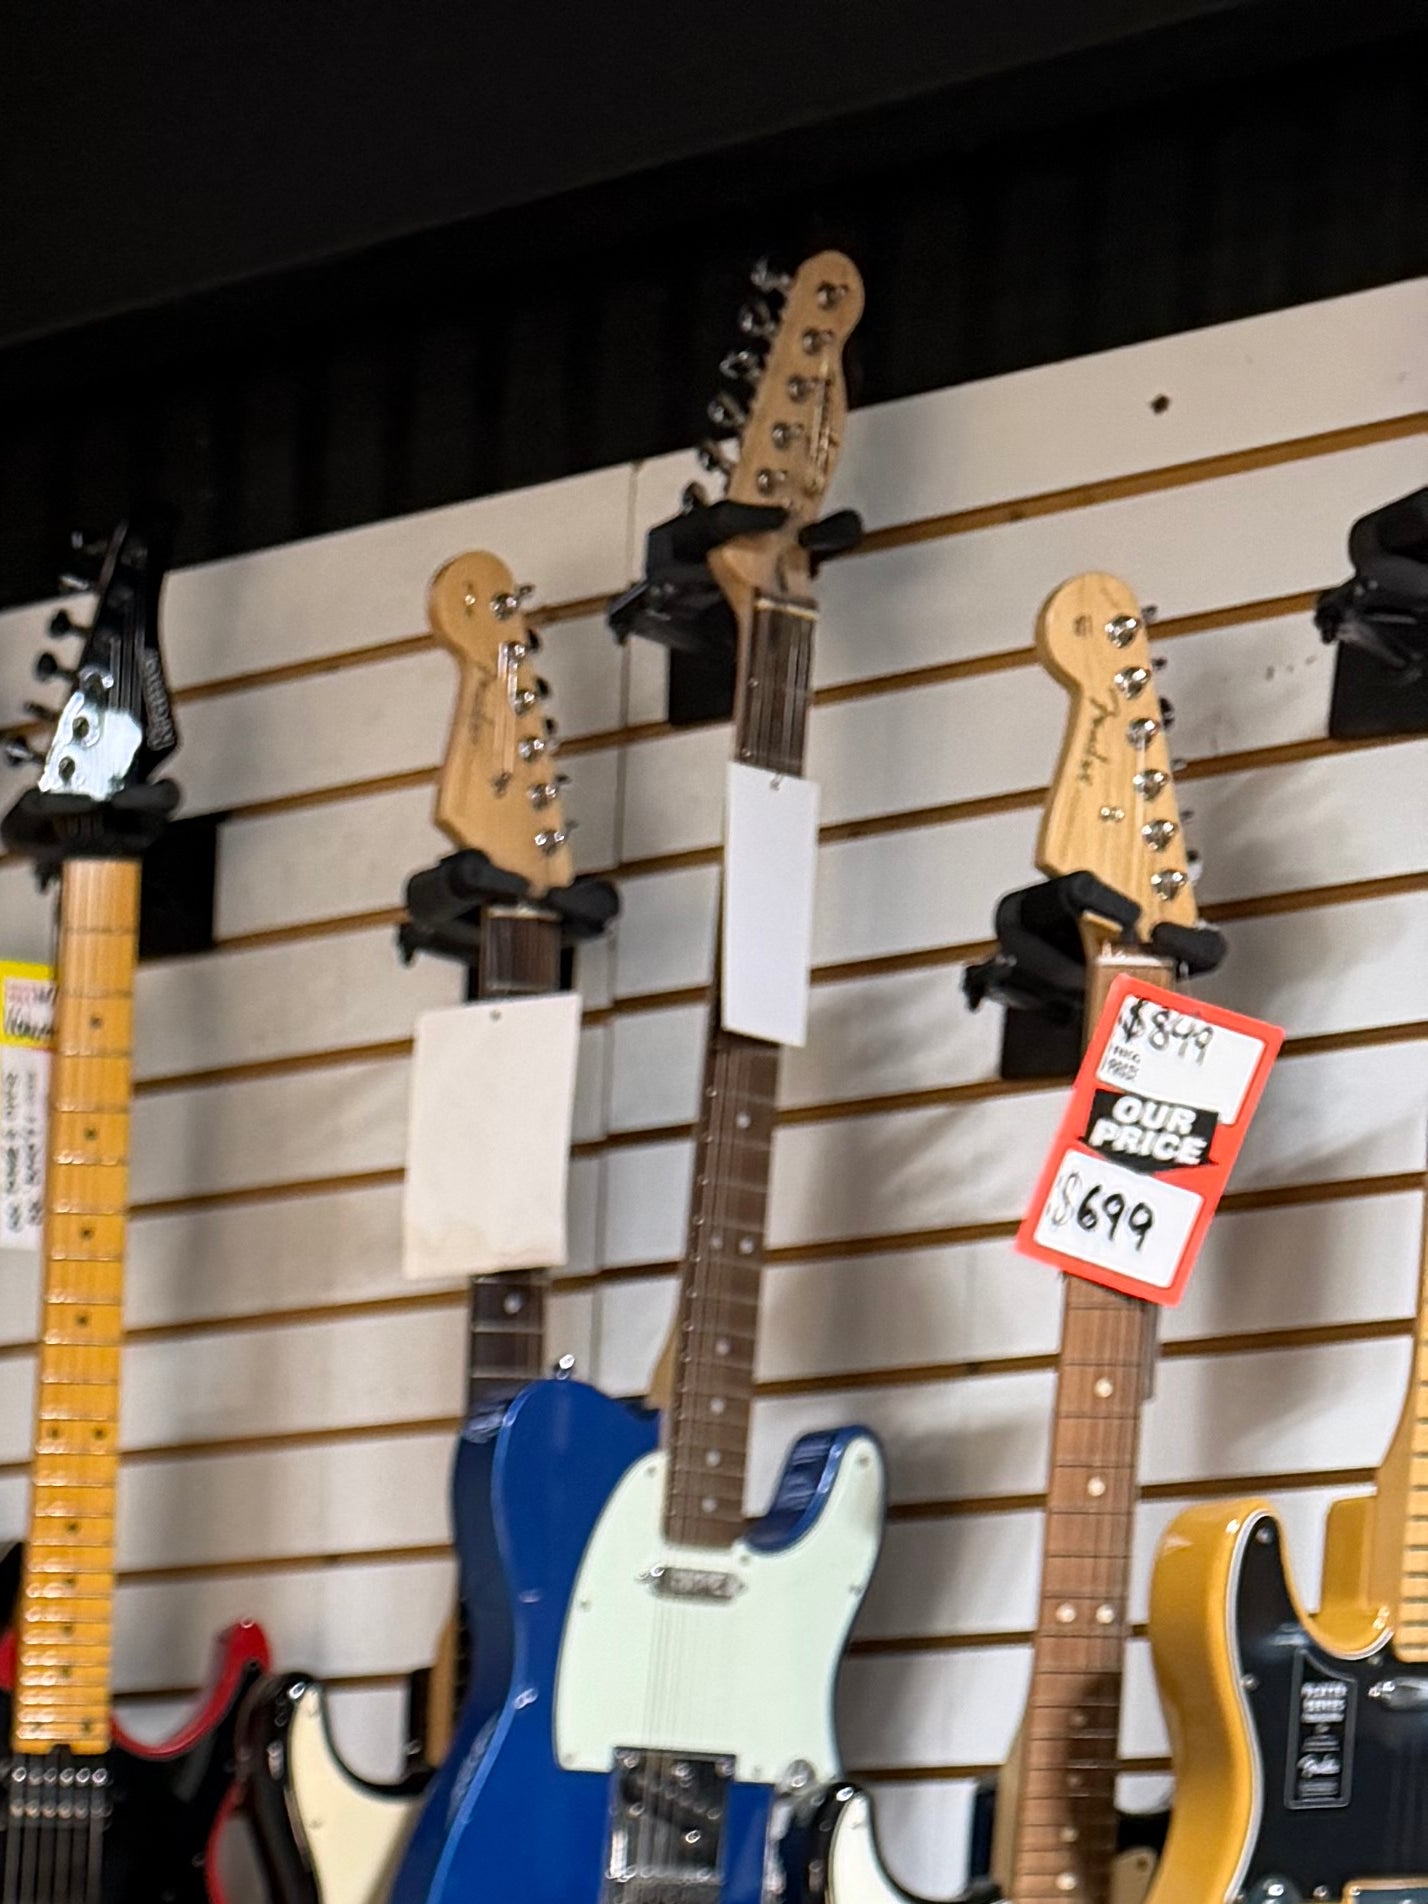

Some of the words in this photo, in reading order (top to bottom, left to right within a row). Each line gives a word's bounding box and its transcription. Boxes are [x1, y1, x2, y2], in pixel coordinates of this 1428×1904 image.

[1119, 999, 1214, 1066] $849
[1087, 1117, 1208, 1166] PRICE
[1112, 1094, 1198, 1135] OUR
[1046, 1170, 1155, 1252] $699
